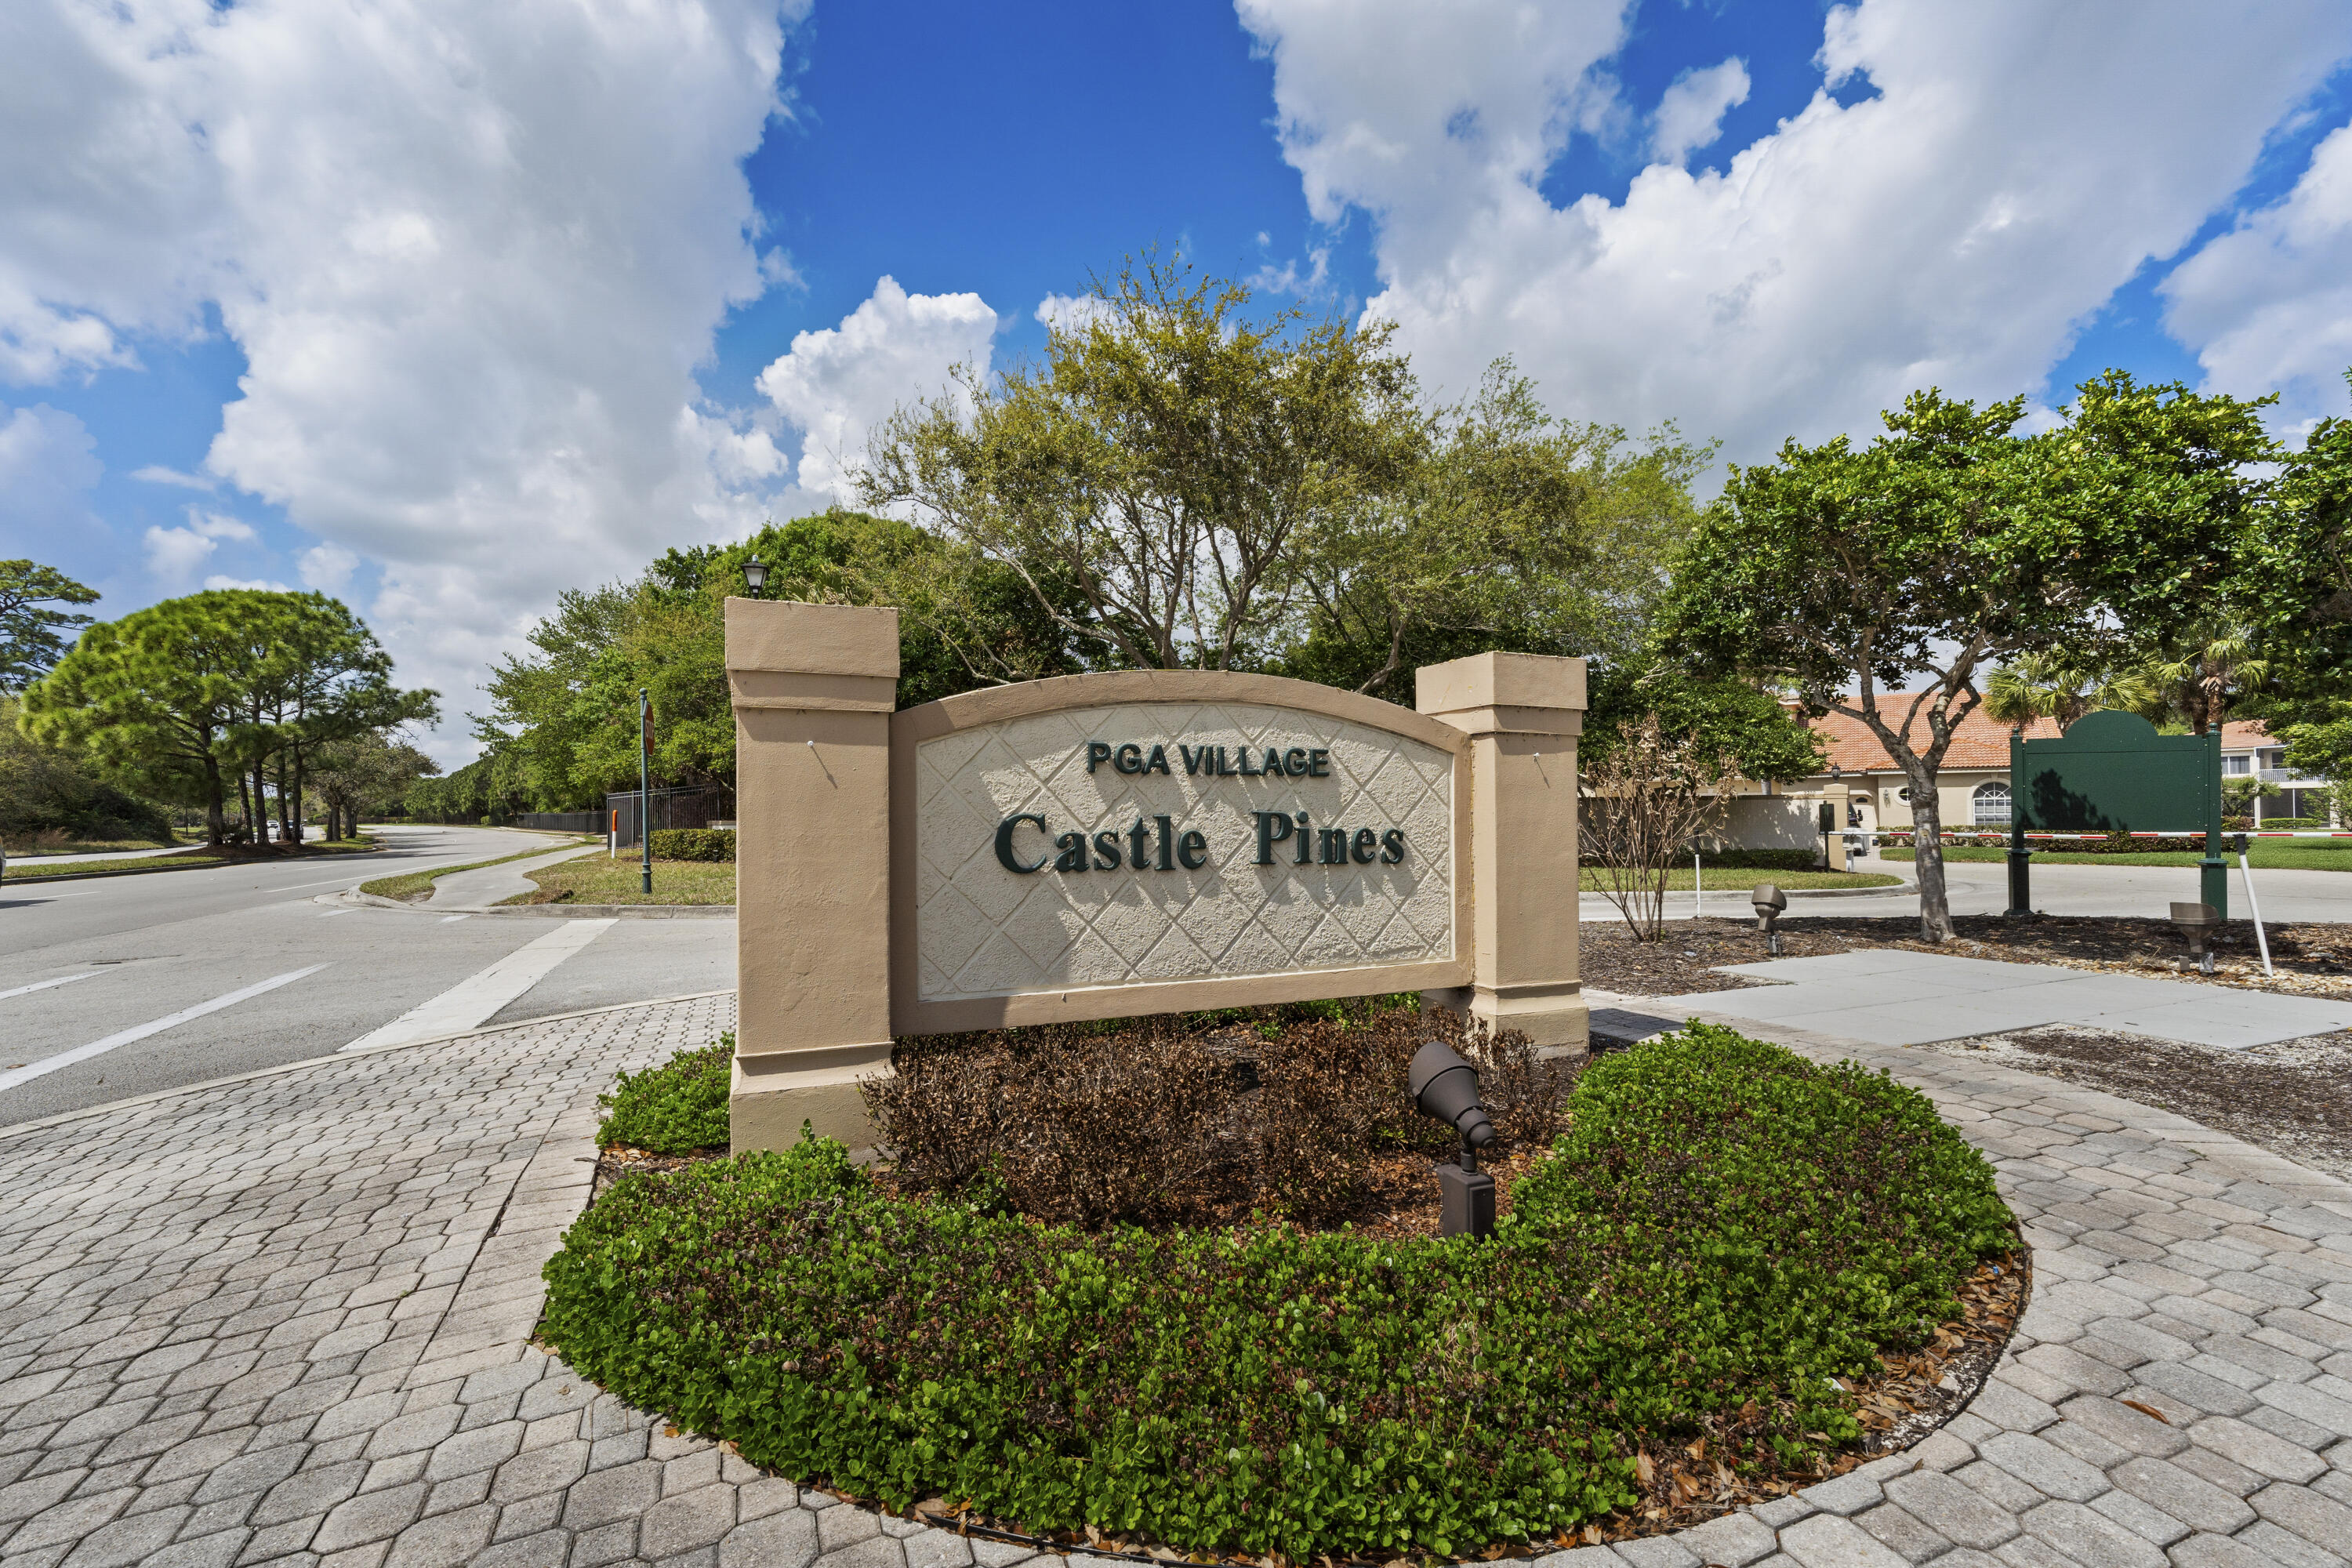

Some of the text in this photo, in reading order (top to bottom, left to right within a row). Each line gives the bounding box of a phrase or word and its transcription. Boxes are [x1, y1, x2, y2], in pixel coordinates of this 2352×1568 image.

[1087, 740, 1330, 777] PGA VILLAGE
[994, 810, 1405, 873] Castle Pines
